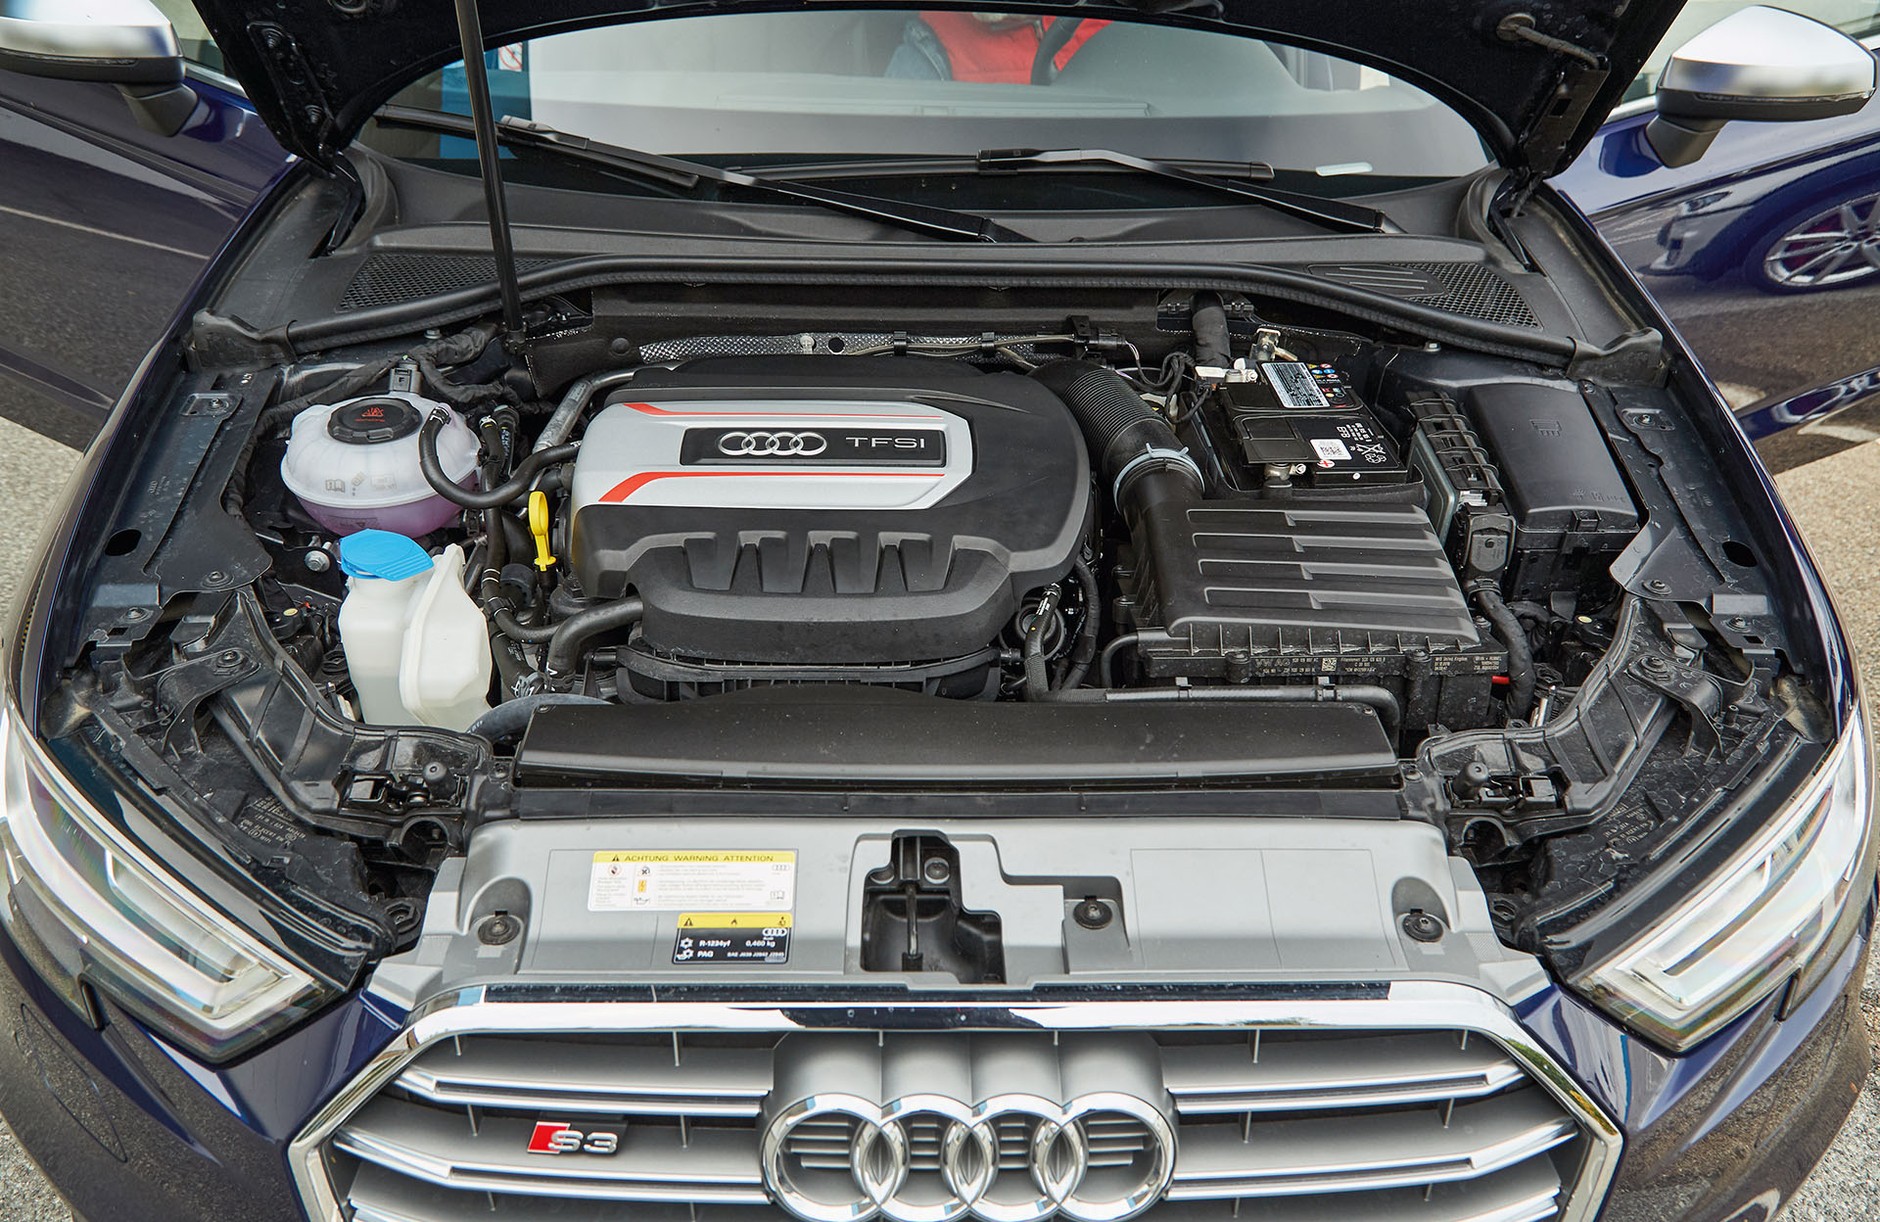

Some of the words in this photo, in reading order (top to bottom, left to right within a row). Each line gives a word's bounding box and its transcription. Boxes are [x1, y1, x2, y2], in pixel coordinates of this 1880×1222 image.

[845, 436, 925, 449] TFSI
[624, 854, 669, 862] ACHTUNG
[673, 854, 719, 862] WARNING
[723, 854, 774, 862] ATTENTION
[766, 939, 776, 948] kg
[697, 950, 714, 958] PAG
[548, 1130, 618, 1153] S3
